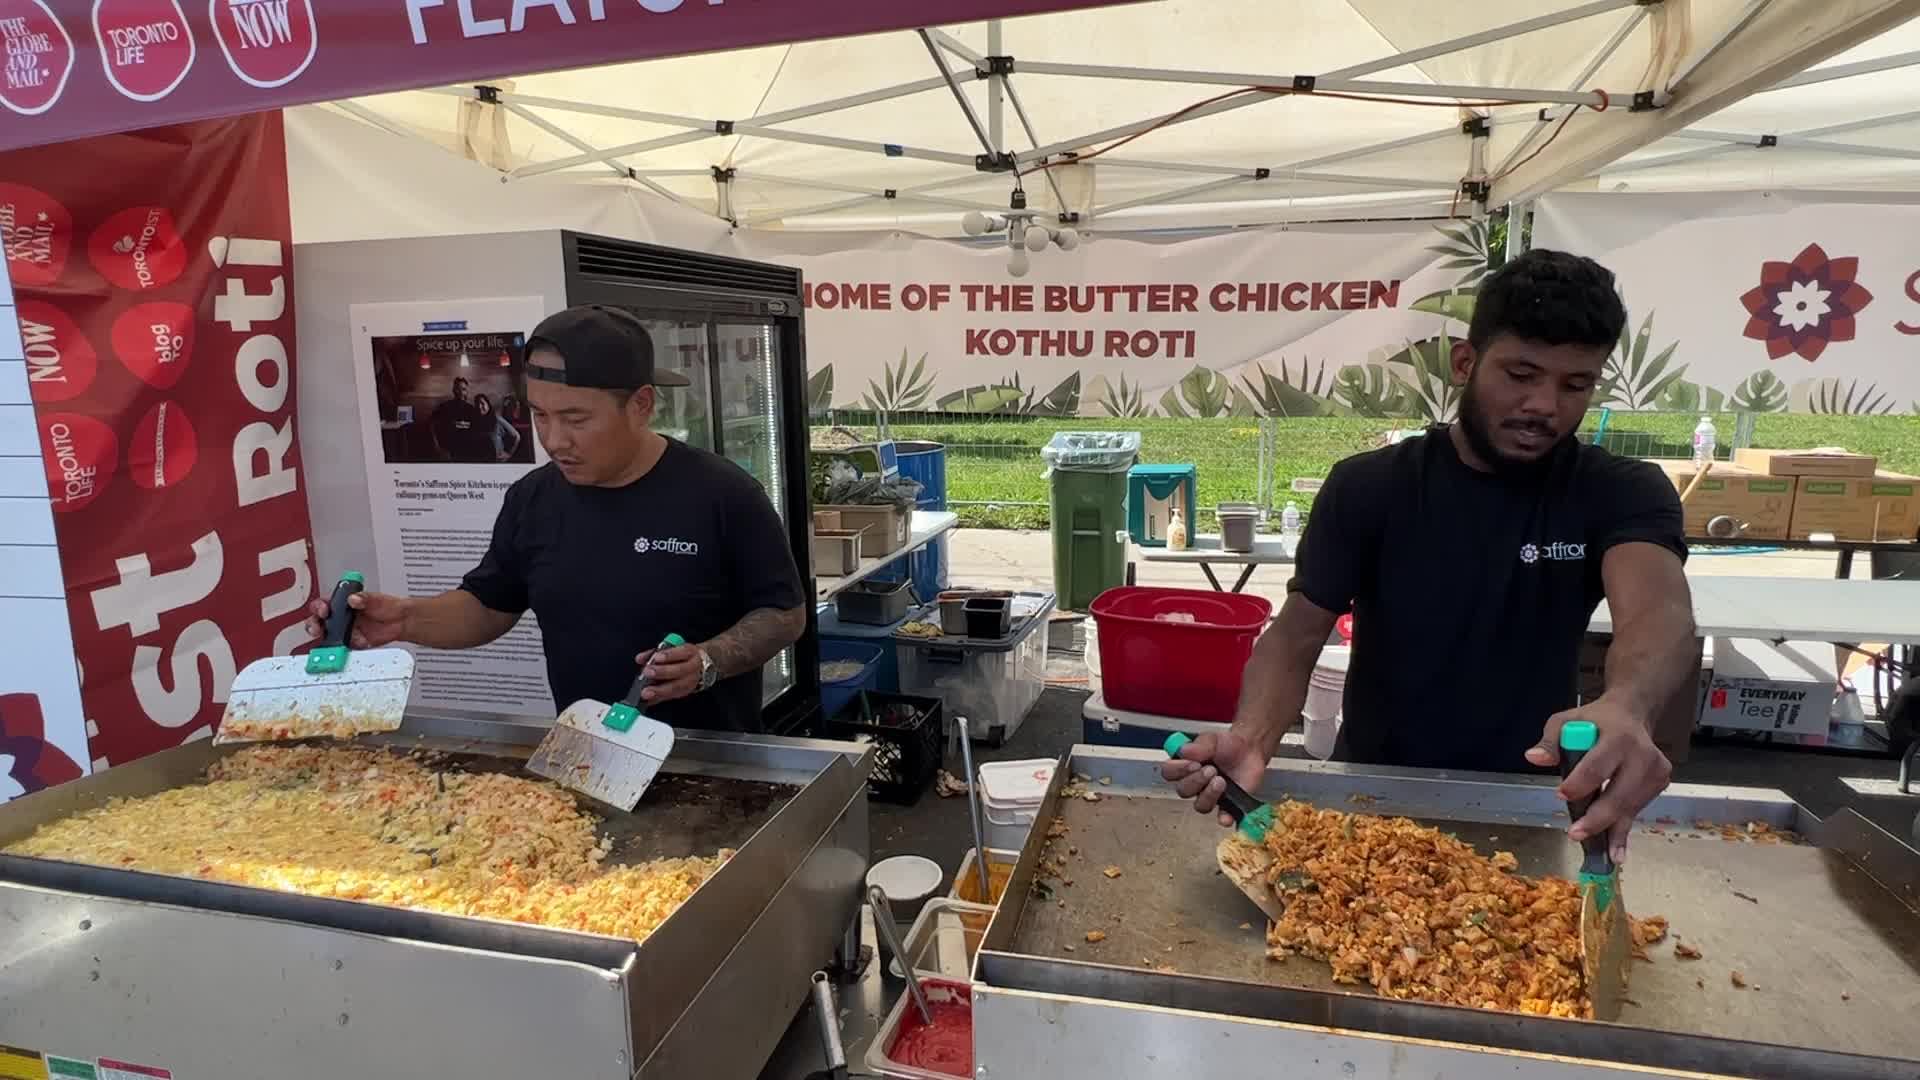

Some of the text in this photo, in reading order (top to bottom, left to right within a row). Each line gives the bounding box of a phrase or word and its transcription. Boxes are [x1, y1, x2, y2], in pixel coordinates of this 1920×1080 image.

[0, 17, 31, 38] THE
[107, 22, 178, 48] TORONTO
[230, 0, 292, 49] NOW
[6, 33, 53, 55] GLOBE
[115, 46, 145, 66] LIFE
[5, 54, 38, 71] AND
[6, 69, 43, 88] MAIL
[15, 226, 34, 263] AND
[33, 222, 55, 264] MAIL
[133, 209, 160, 289] TORONTOIST
[901, 284, 950, 311] OF
[960, 285, 1034, 312] THE
[1044, 284, 1199, 313] BUTTER
[1209, 280, 1401, 312] CHICKEN
[20, 318, 67, 383] NOW
[151, 324, 170, 364] blog
[966, 328, 1195, 358] KOTHU ROTI
[208, 236, 297, 507] Roti
[51, 423, 81, 504] TORONTO
[78, 465, 96, 497] LIFE
[651, 538, 698, 553] saffron
[1739, 687, 1806, 701] EVERYDAY
[1739, 700, 1774, 718] Tee
